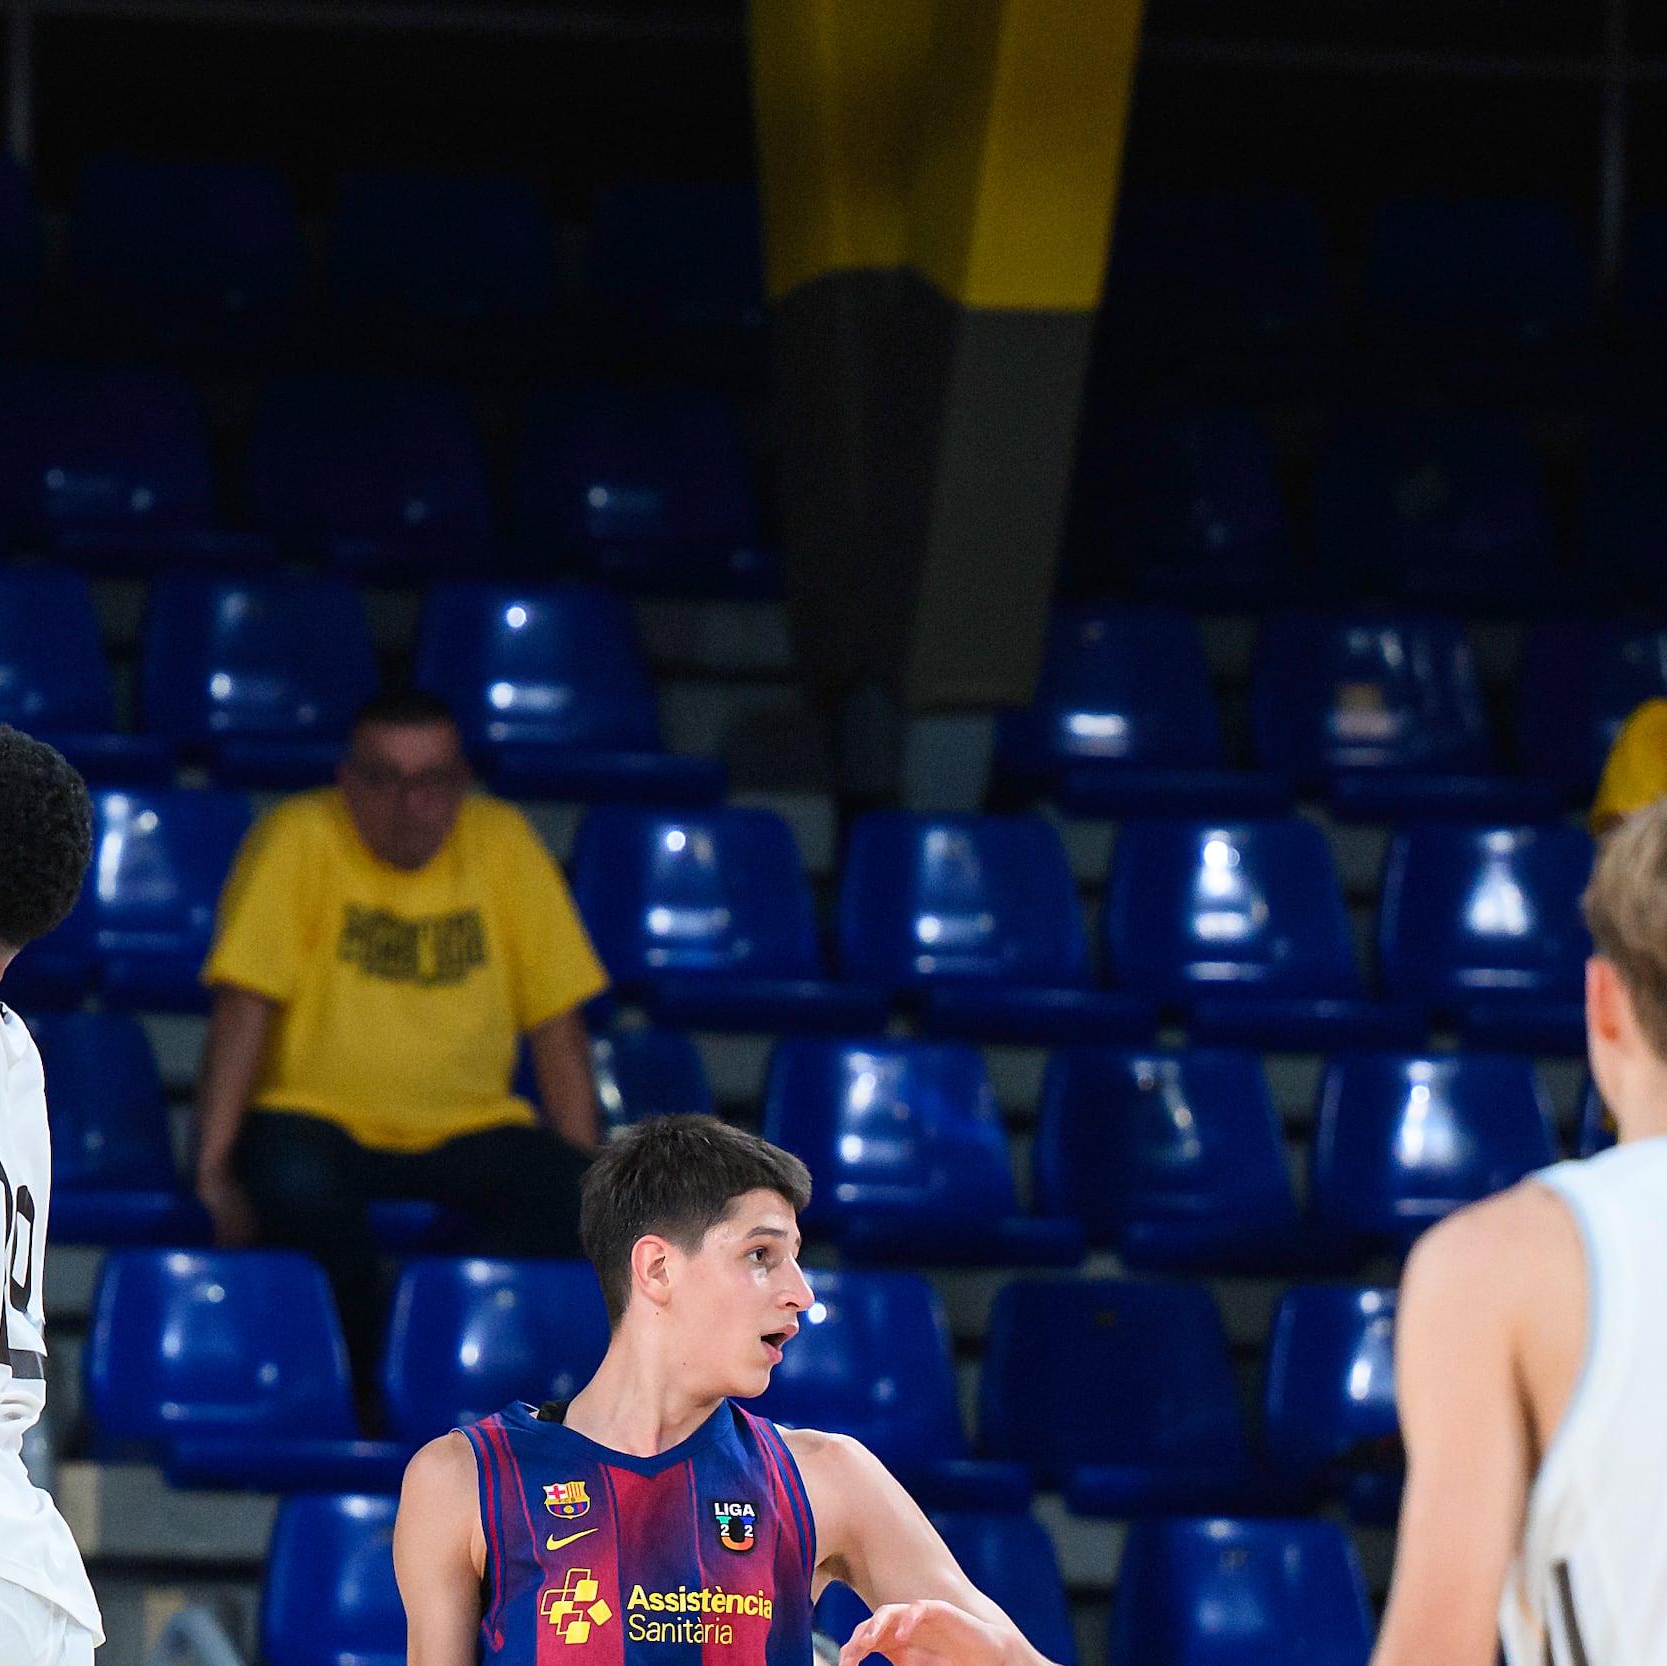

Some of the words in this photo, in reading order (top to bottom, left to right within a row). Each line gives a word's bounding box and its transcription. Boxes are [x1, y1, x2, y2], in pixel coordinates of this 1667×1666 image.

[714, 1502, 756, 1517] LIGA
[627, 1584, 773, 1620] Assistència
[628, 1613, 733, 1645] Sanitària
